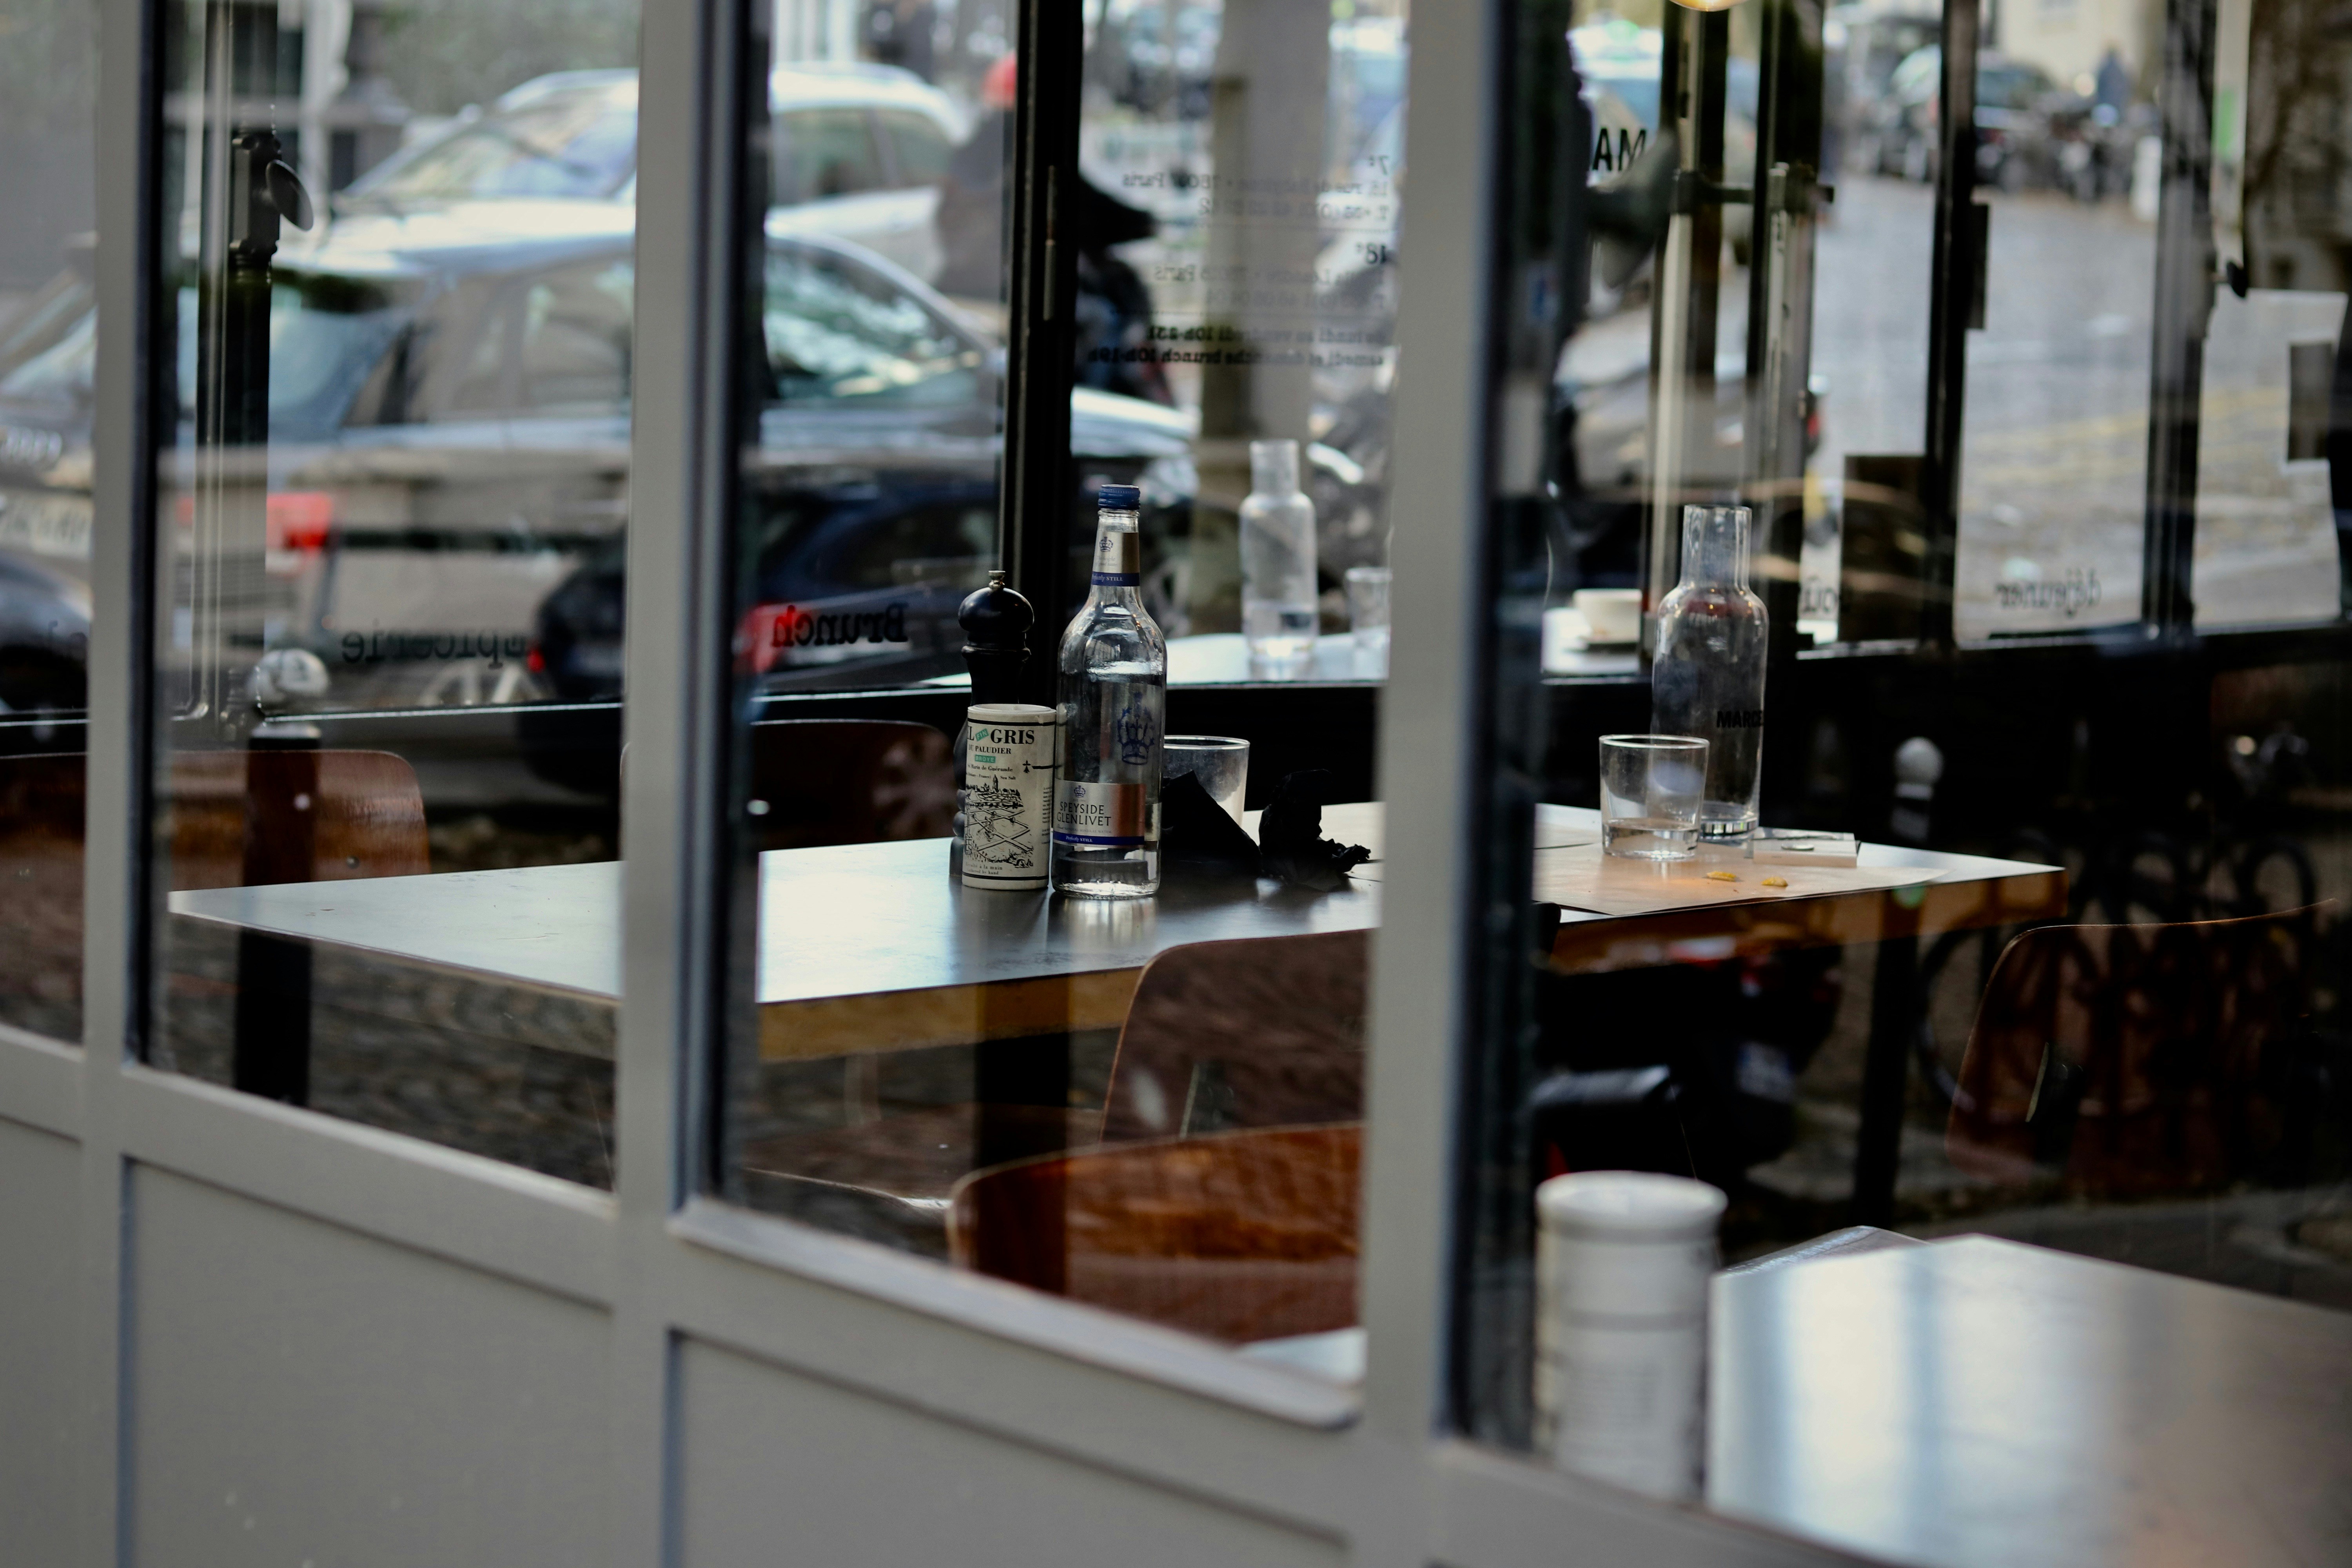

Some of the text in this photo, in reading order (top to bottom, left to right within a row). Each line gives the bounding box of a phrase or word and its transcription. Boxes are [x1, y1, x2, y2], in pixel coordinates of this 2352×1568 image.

[991, 729, 1034, 744] GRIS
[975, 746, 1011, 754] PALUDIER
[1060, 801, 1104, 815] SPEYSIDE
[1056, 812, 1111, 826] GLENLIVET
